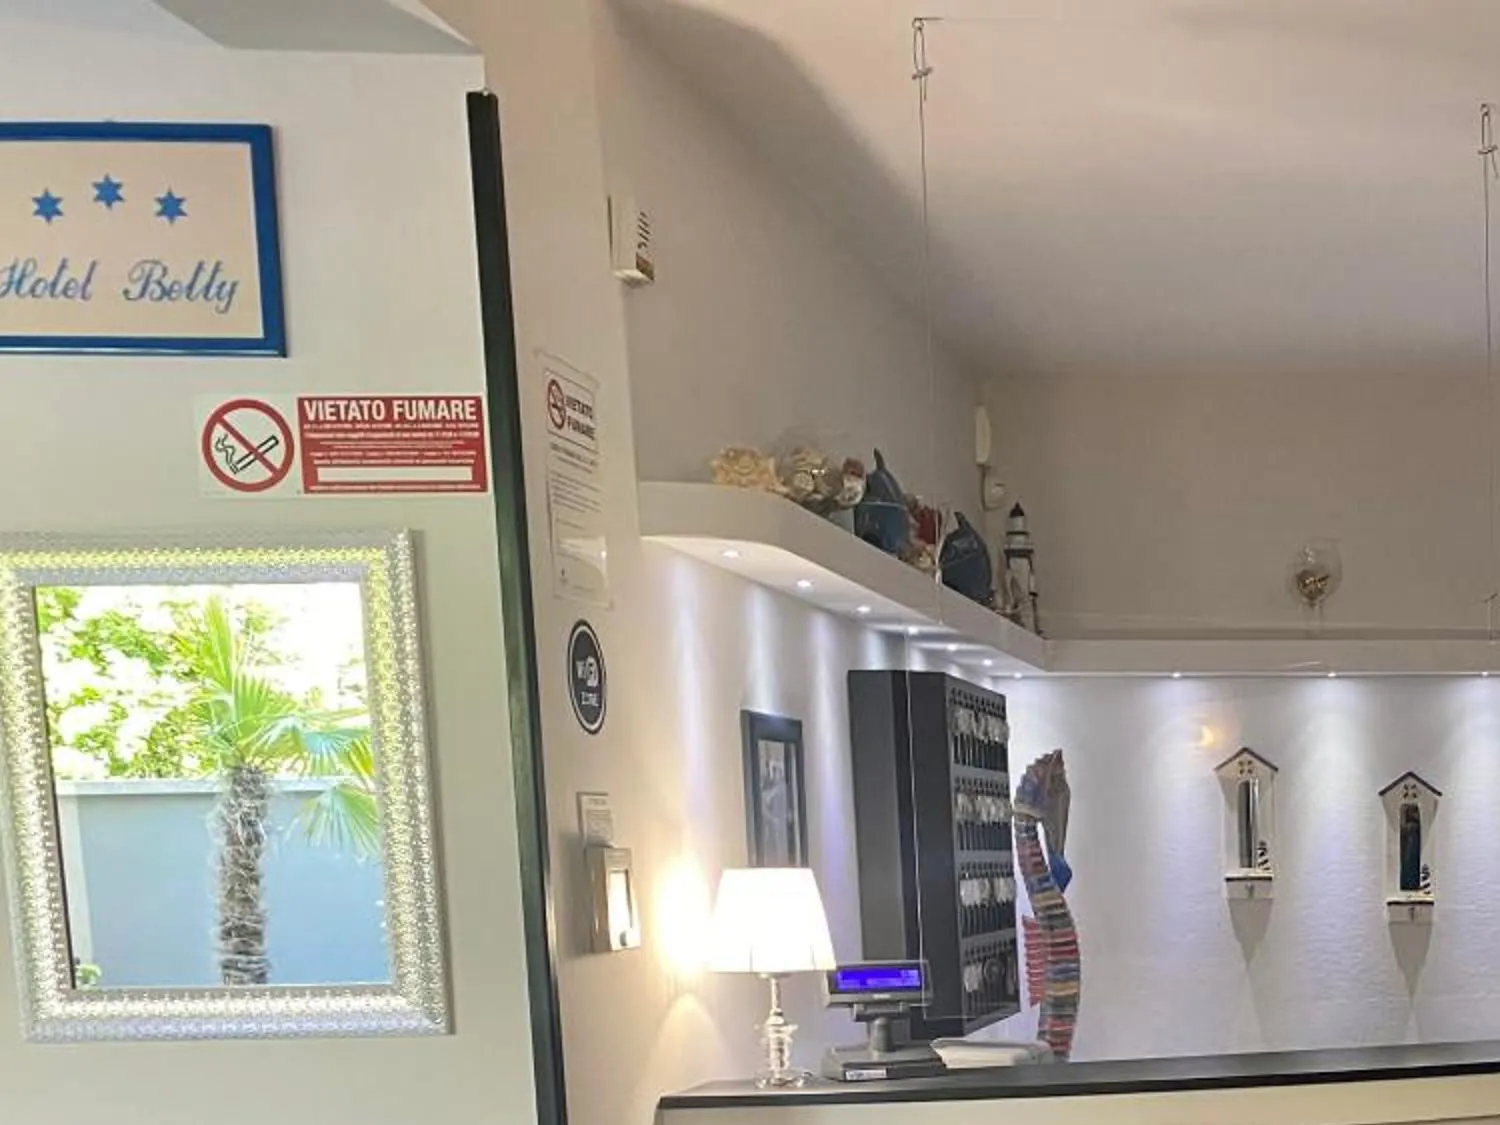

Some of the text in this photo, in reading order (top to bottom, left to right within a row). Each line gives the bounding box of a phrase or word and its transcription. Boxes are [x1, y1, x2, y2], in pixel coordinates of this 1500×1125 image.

[0, 257, 240, 315] Hotel Betty
[303, 399, 478, 421] VIETATO FUMARE
